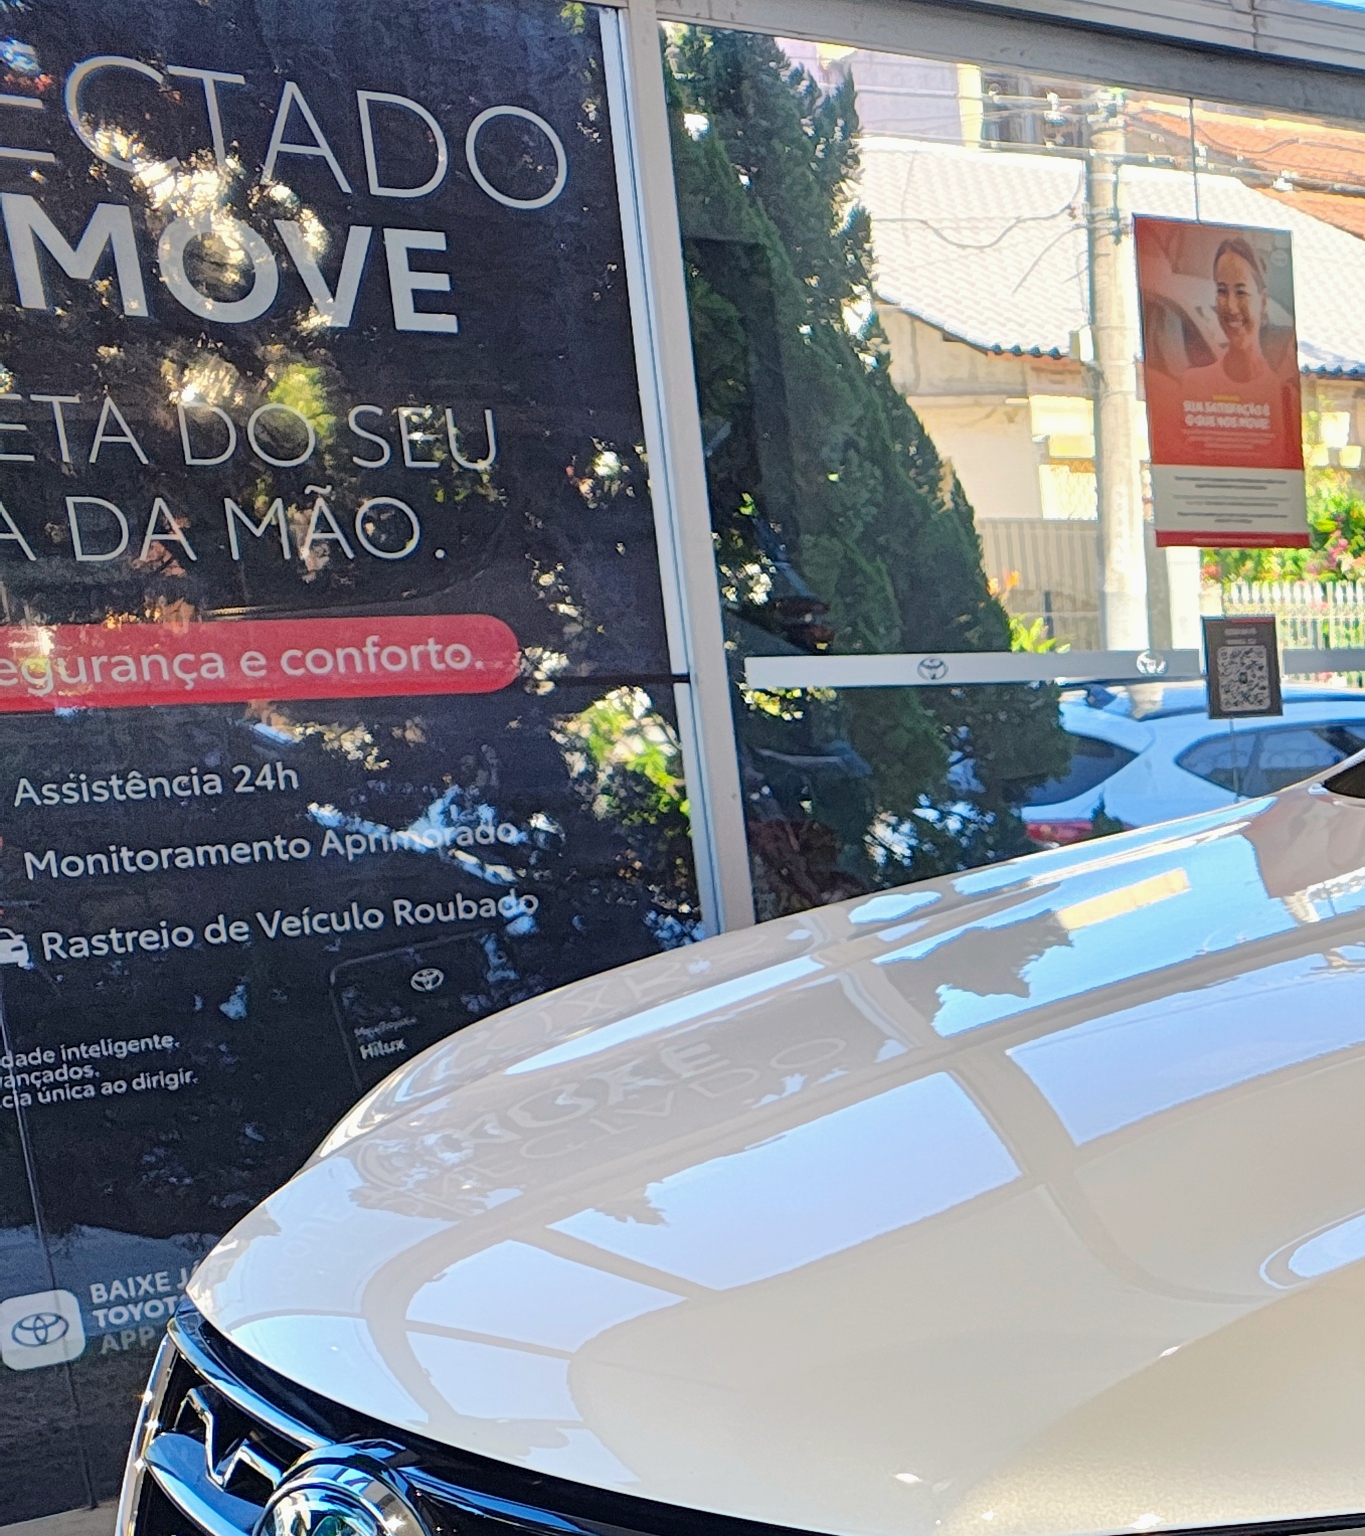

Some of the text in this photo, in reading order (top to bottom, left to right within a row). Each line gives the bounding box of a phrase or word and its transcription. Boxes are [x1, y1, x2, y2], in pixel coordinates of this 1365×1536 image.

[1, 192, 459, 333] MOVE
[177, 401, 317, 467] DO
[348, 404, 499, 470] SEU
[66, 495, 198, 562] DA
[223, 484, 448, 560] MÃO.
[239, 651, 267, 678] e
[280, 633, 485, 679] conforto.
[14, 762, 299, 808] Assistência 24h
[24, 820, 520, 881] Monitoramento Aprimorado
[41, 890, 540, 963] Rastreio de Veículo Roubado
[60, 1034, 181, 1059] inteligente.
[37, 1083, 96, 1105] única
[100, 1080, 128, 1096] ao
[132, 1067, 199, 1091] dirigir.
[90, 1271, 171, 1304] BAIXE
[92, 1294, 187, 1328] TOYOT
[101, 1325, 157, 1354] APP
